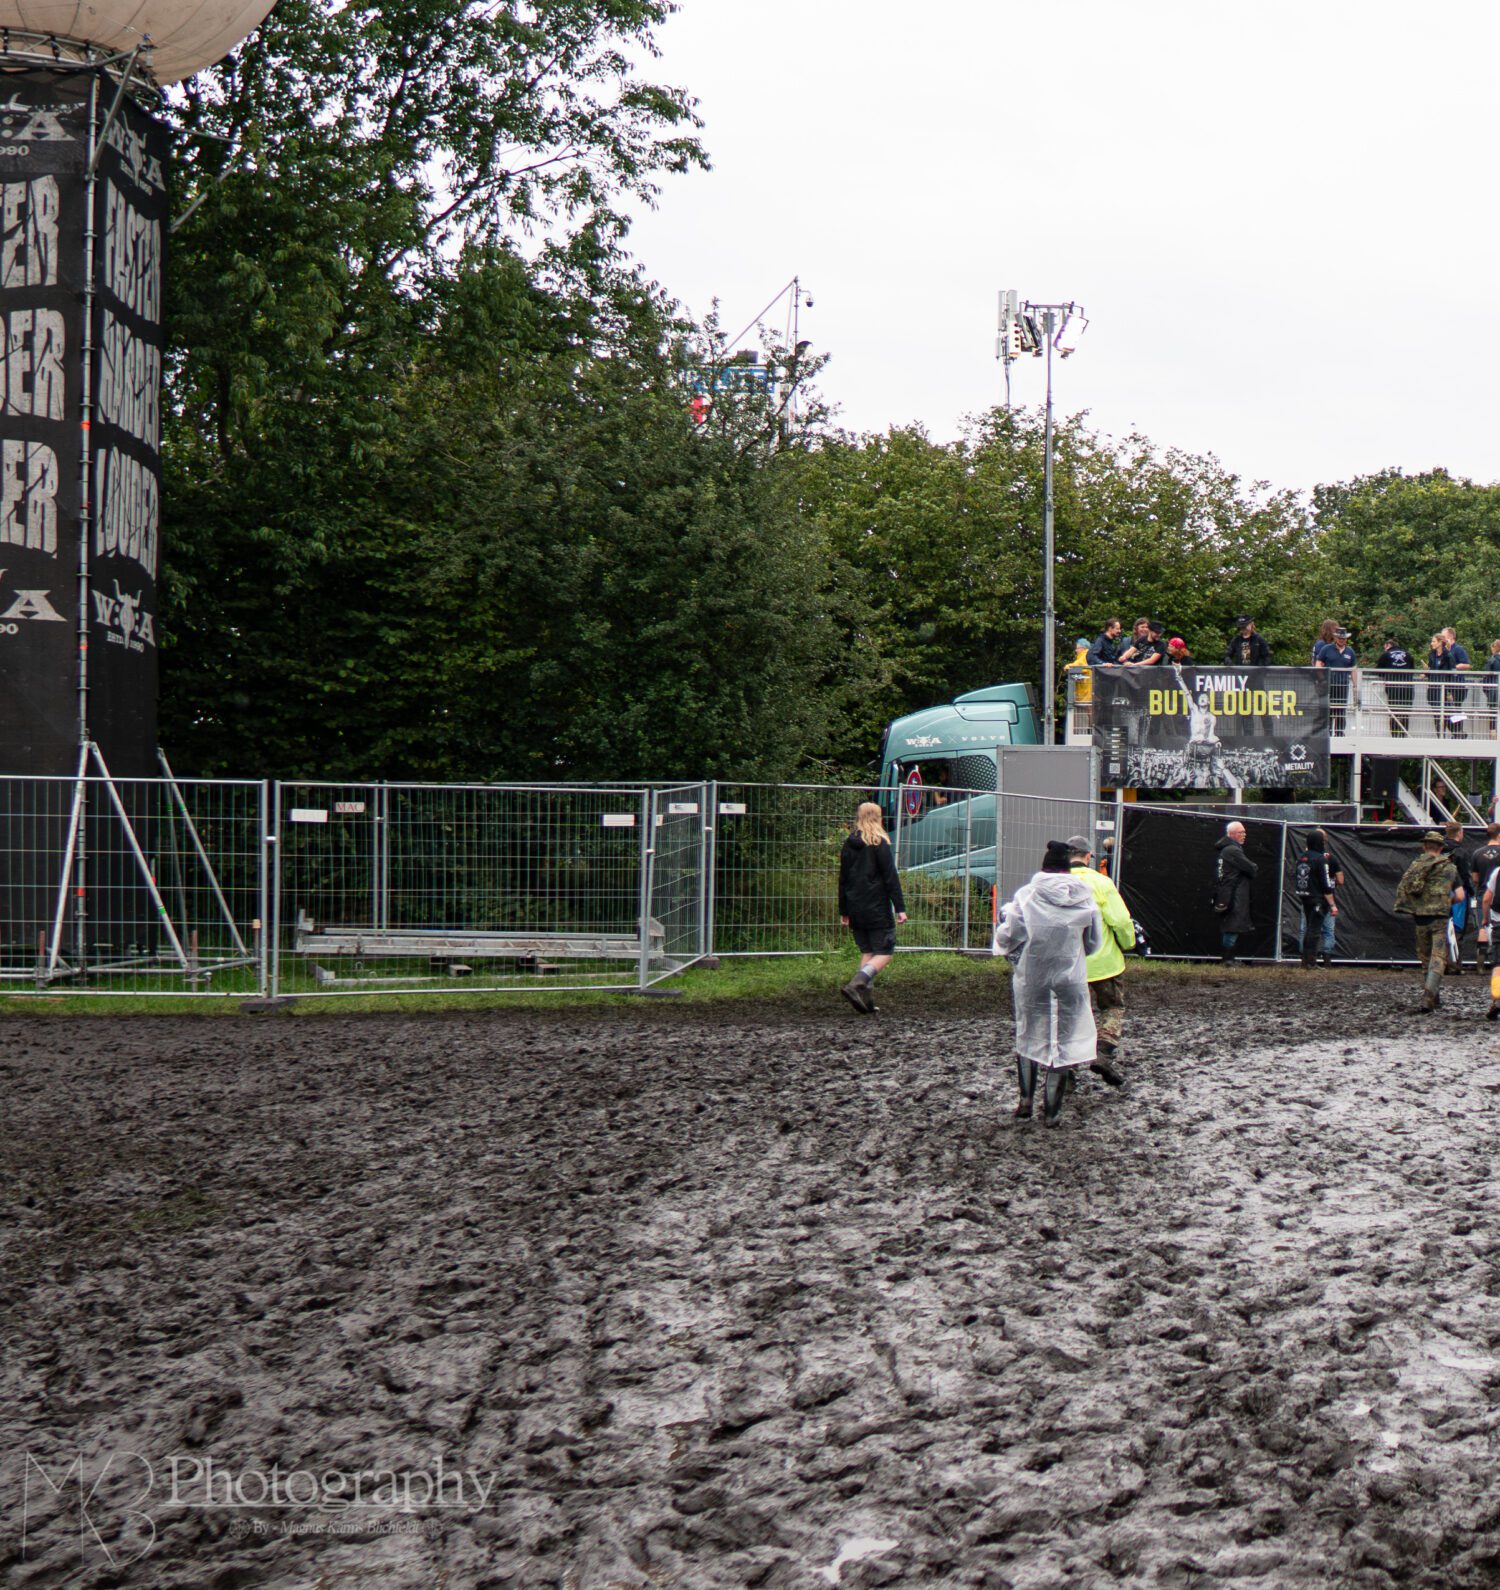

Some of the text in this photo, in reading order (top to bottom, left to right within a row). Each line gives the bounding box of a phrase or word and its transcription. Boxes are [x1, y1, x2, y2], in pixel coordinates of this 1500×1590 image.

[105, 176, 161, 325] FASTER
[98, 308, 161, 455] HARDER
[96, 446, 159, 581] LOUDER
[1150, 690, 1303, 716] BUT LOUDER.
[1196, 675, 1250, 692] FAMILY.
[1284, 761, 1315, 770] METALITY
